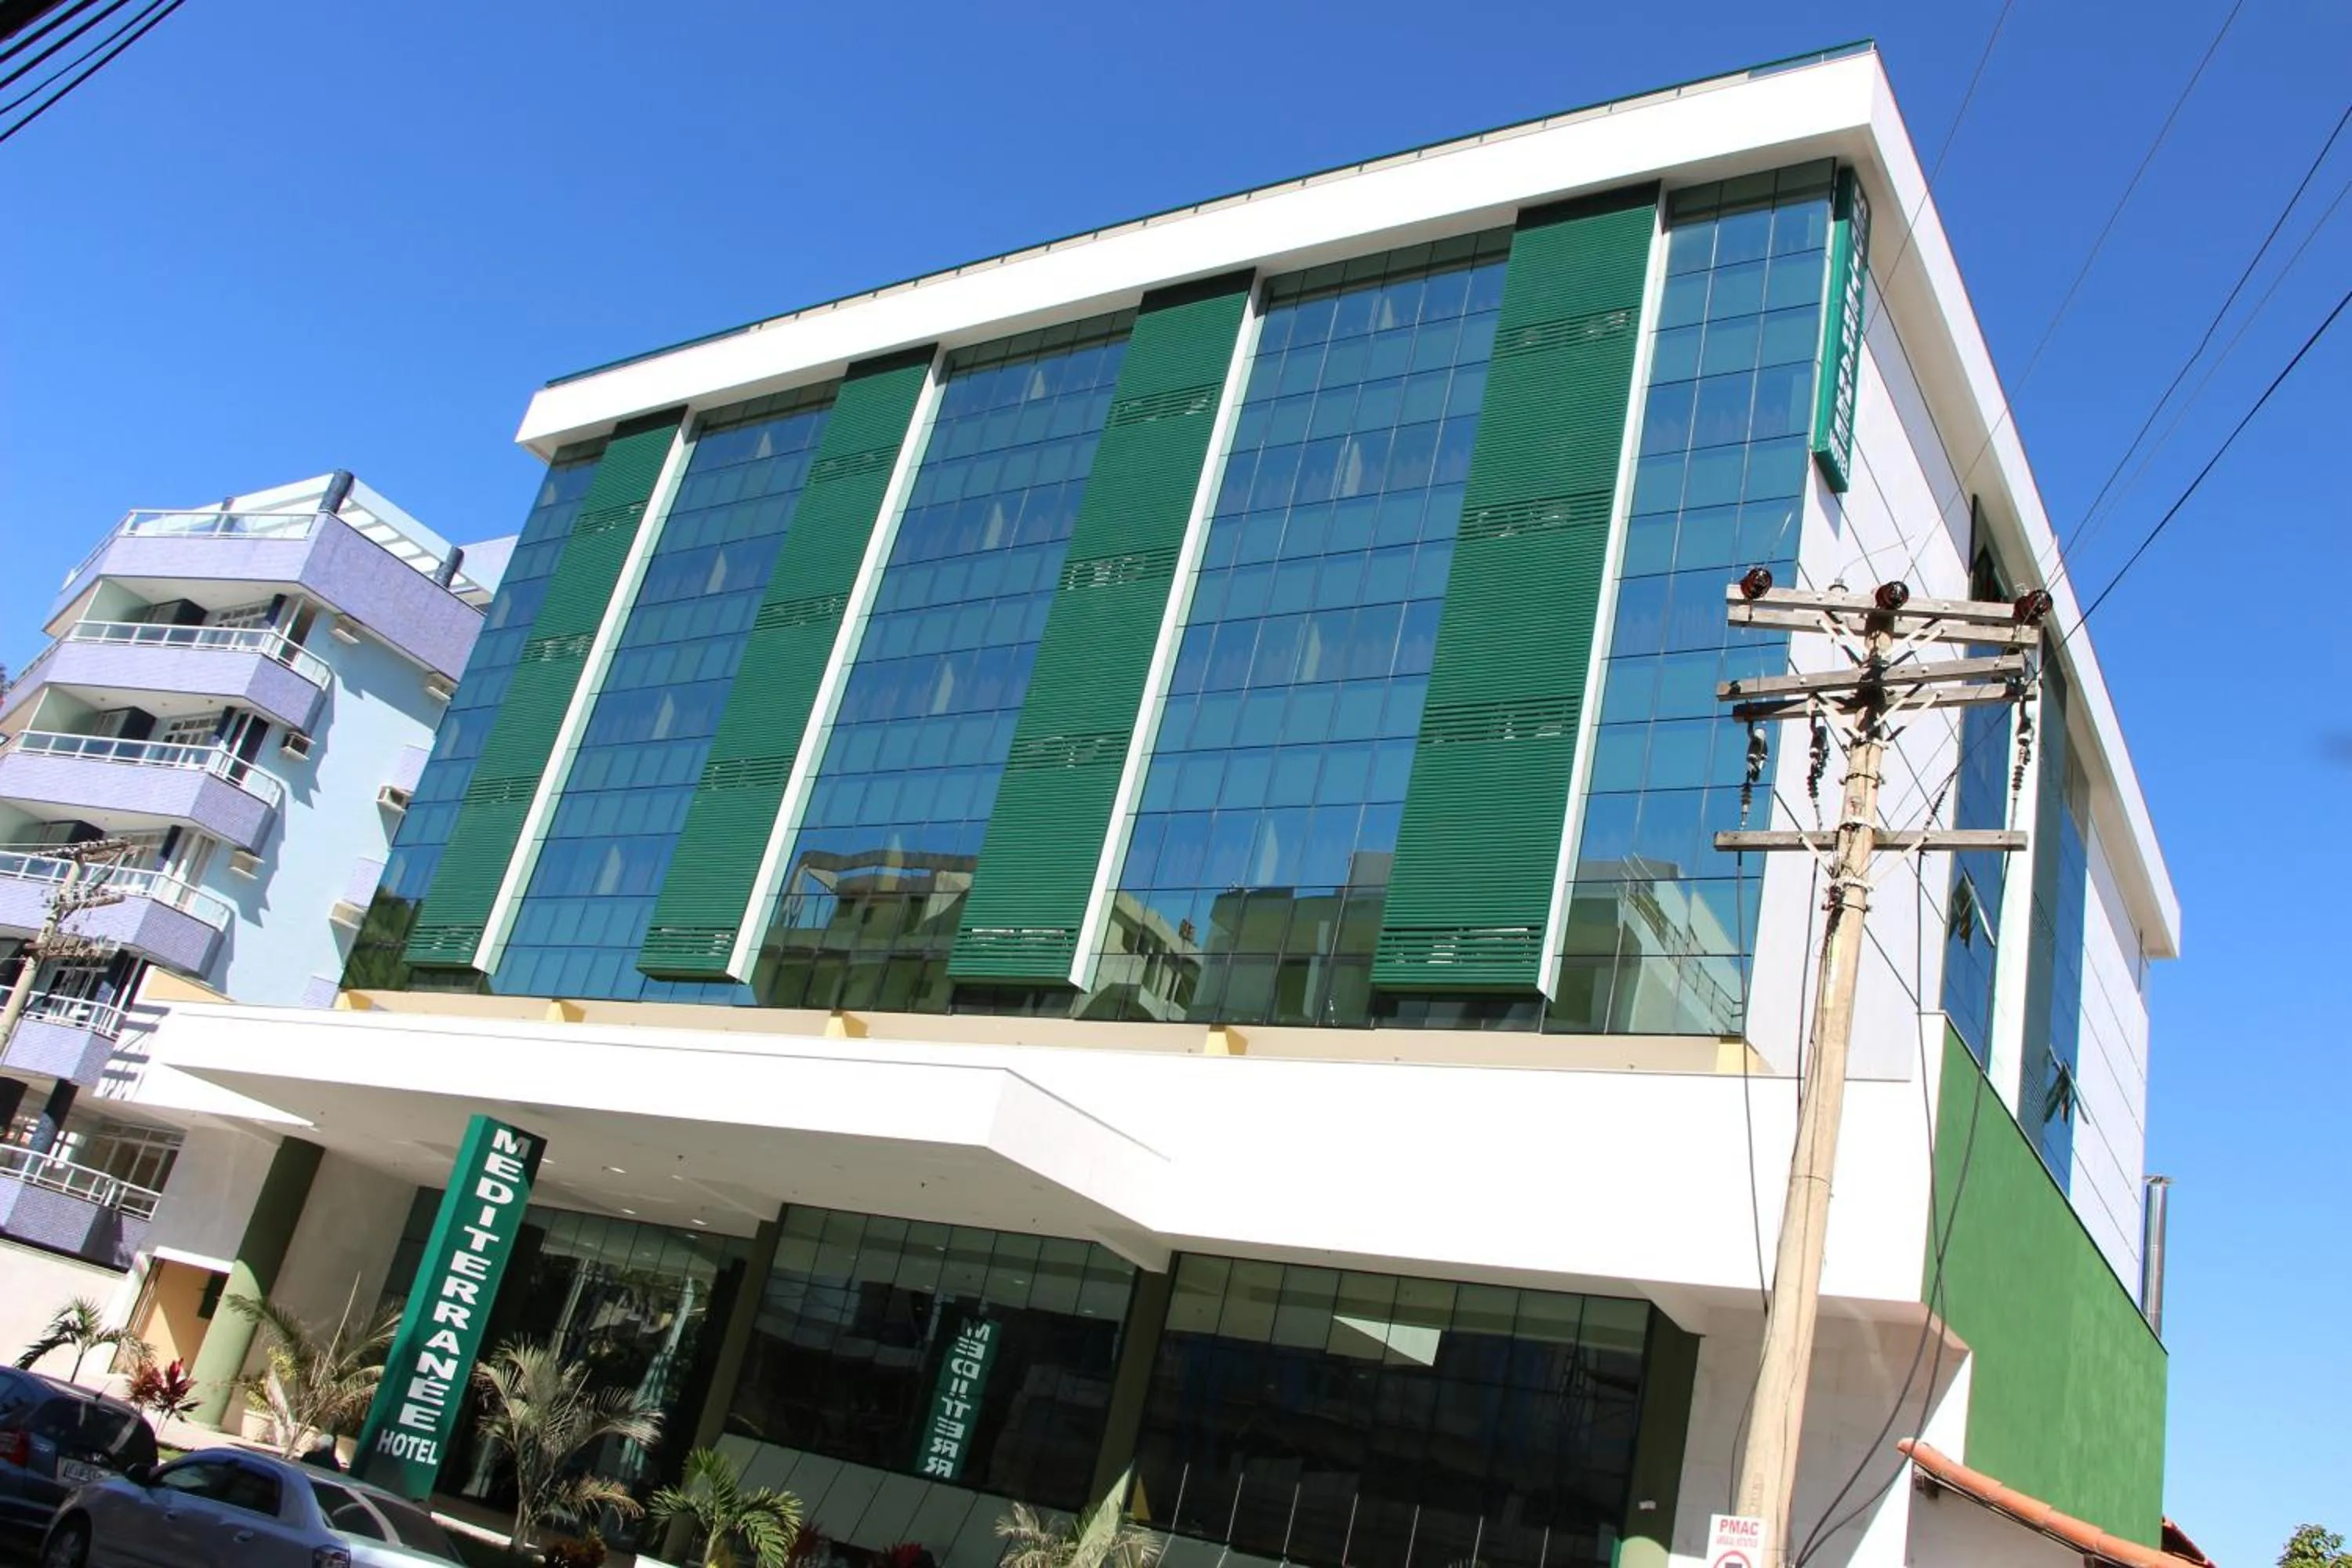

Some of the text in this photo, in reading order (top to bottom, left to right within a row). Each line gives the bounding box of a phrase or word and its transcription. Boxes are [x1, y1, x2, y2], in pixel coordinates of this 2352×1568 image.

[397, 1128, 531, 1432] MEDITERRANÉE
[376, 1428, 438, 1465] HOTEL
[1720, 1519, 1759, 1536] PMAC
